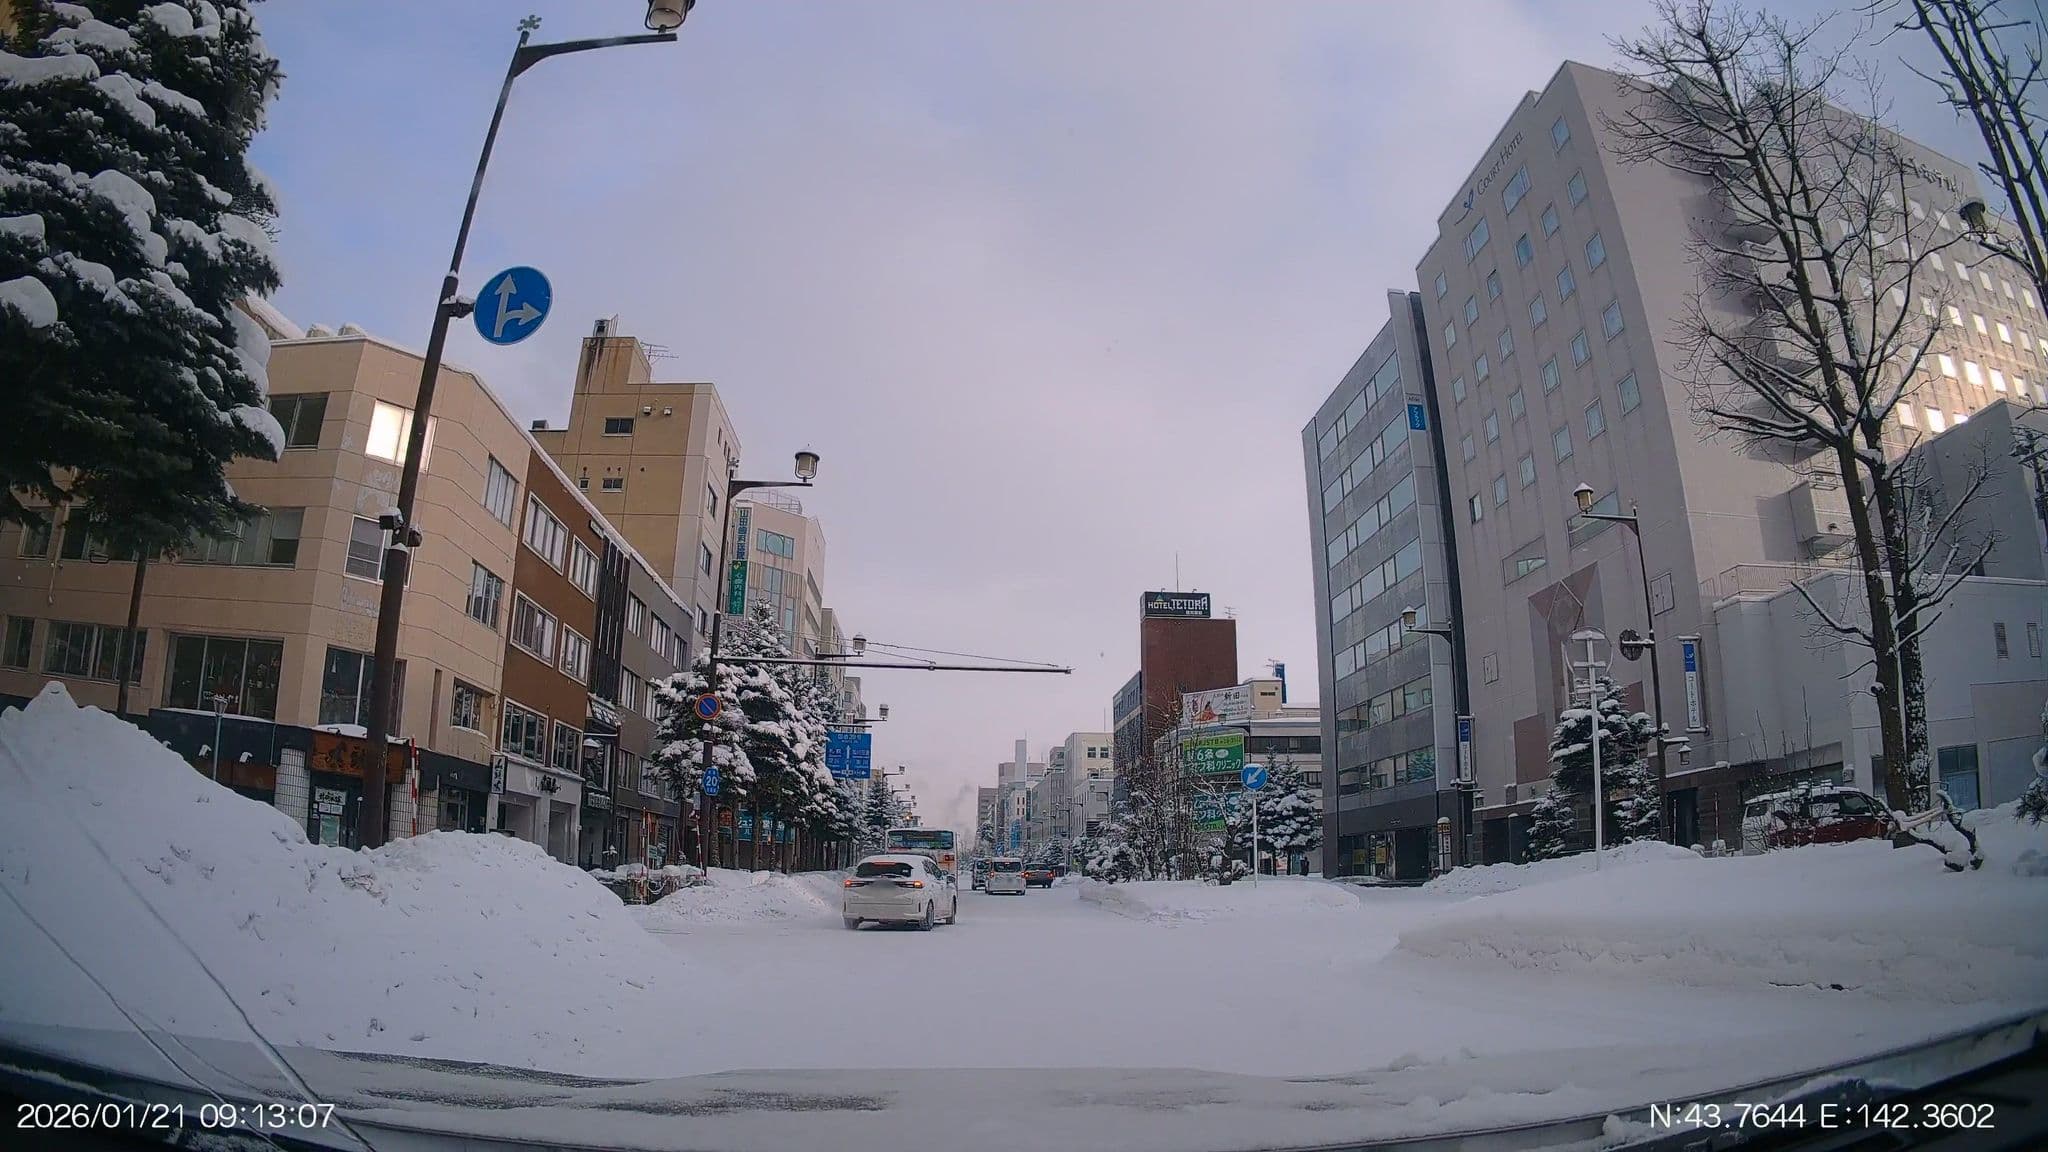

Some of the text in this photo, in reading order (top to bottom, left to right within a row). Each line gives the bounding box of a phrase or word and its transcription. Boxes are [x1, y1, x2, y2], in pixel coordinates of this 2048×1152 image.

[1147, 596, 1208, 611] HOTEL TETORA
[706, 775, 718, 787] 20
